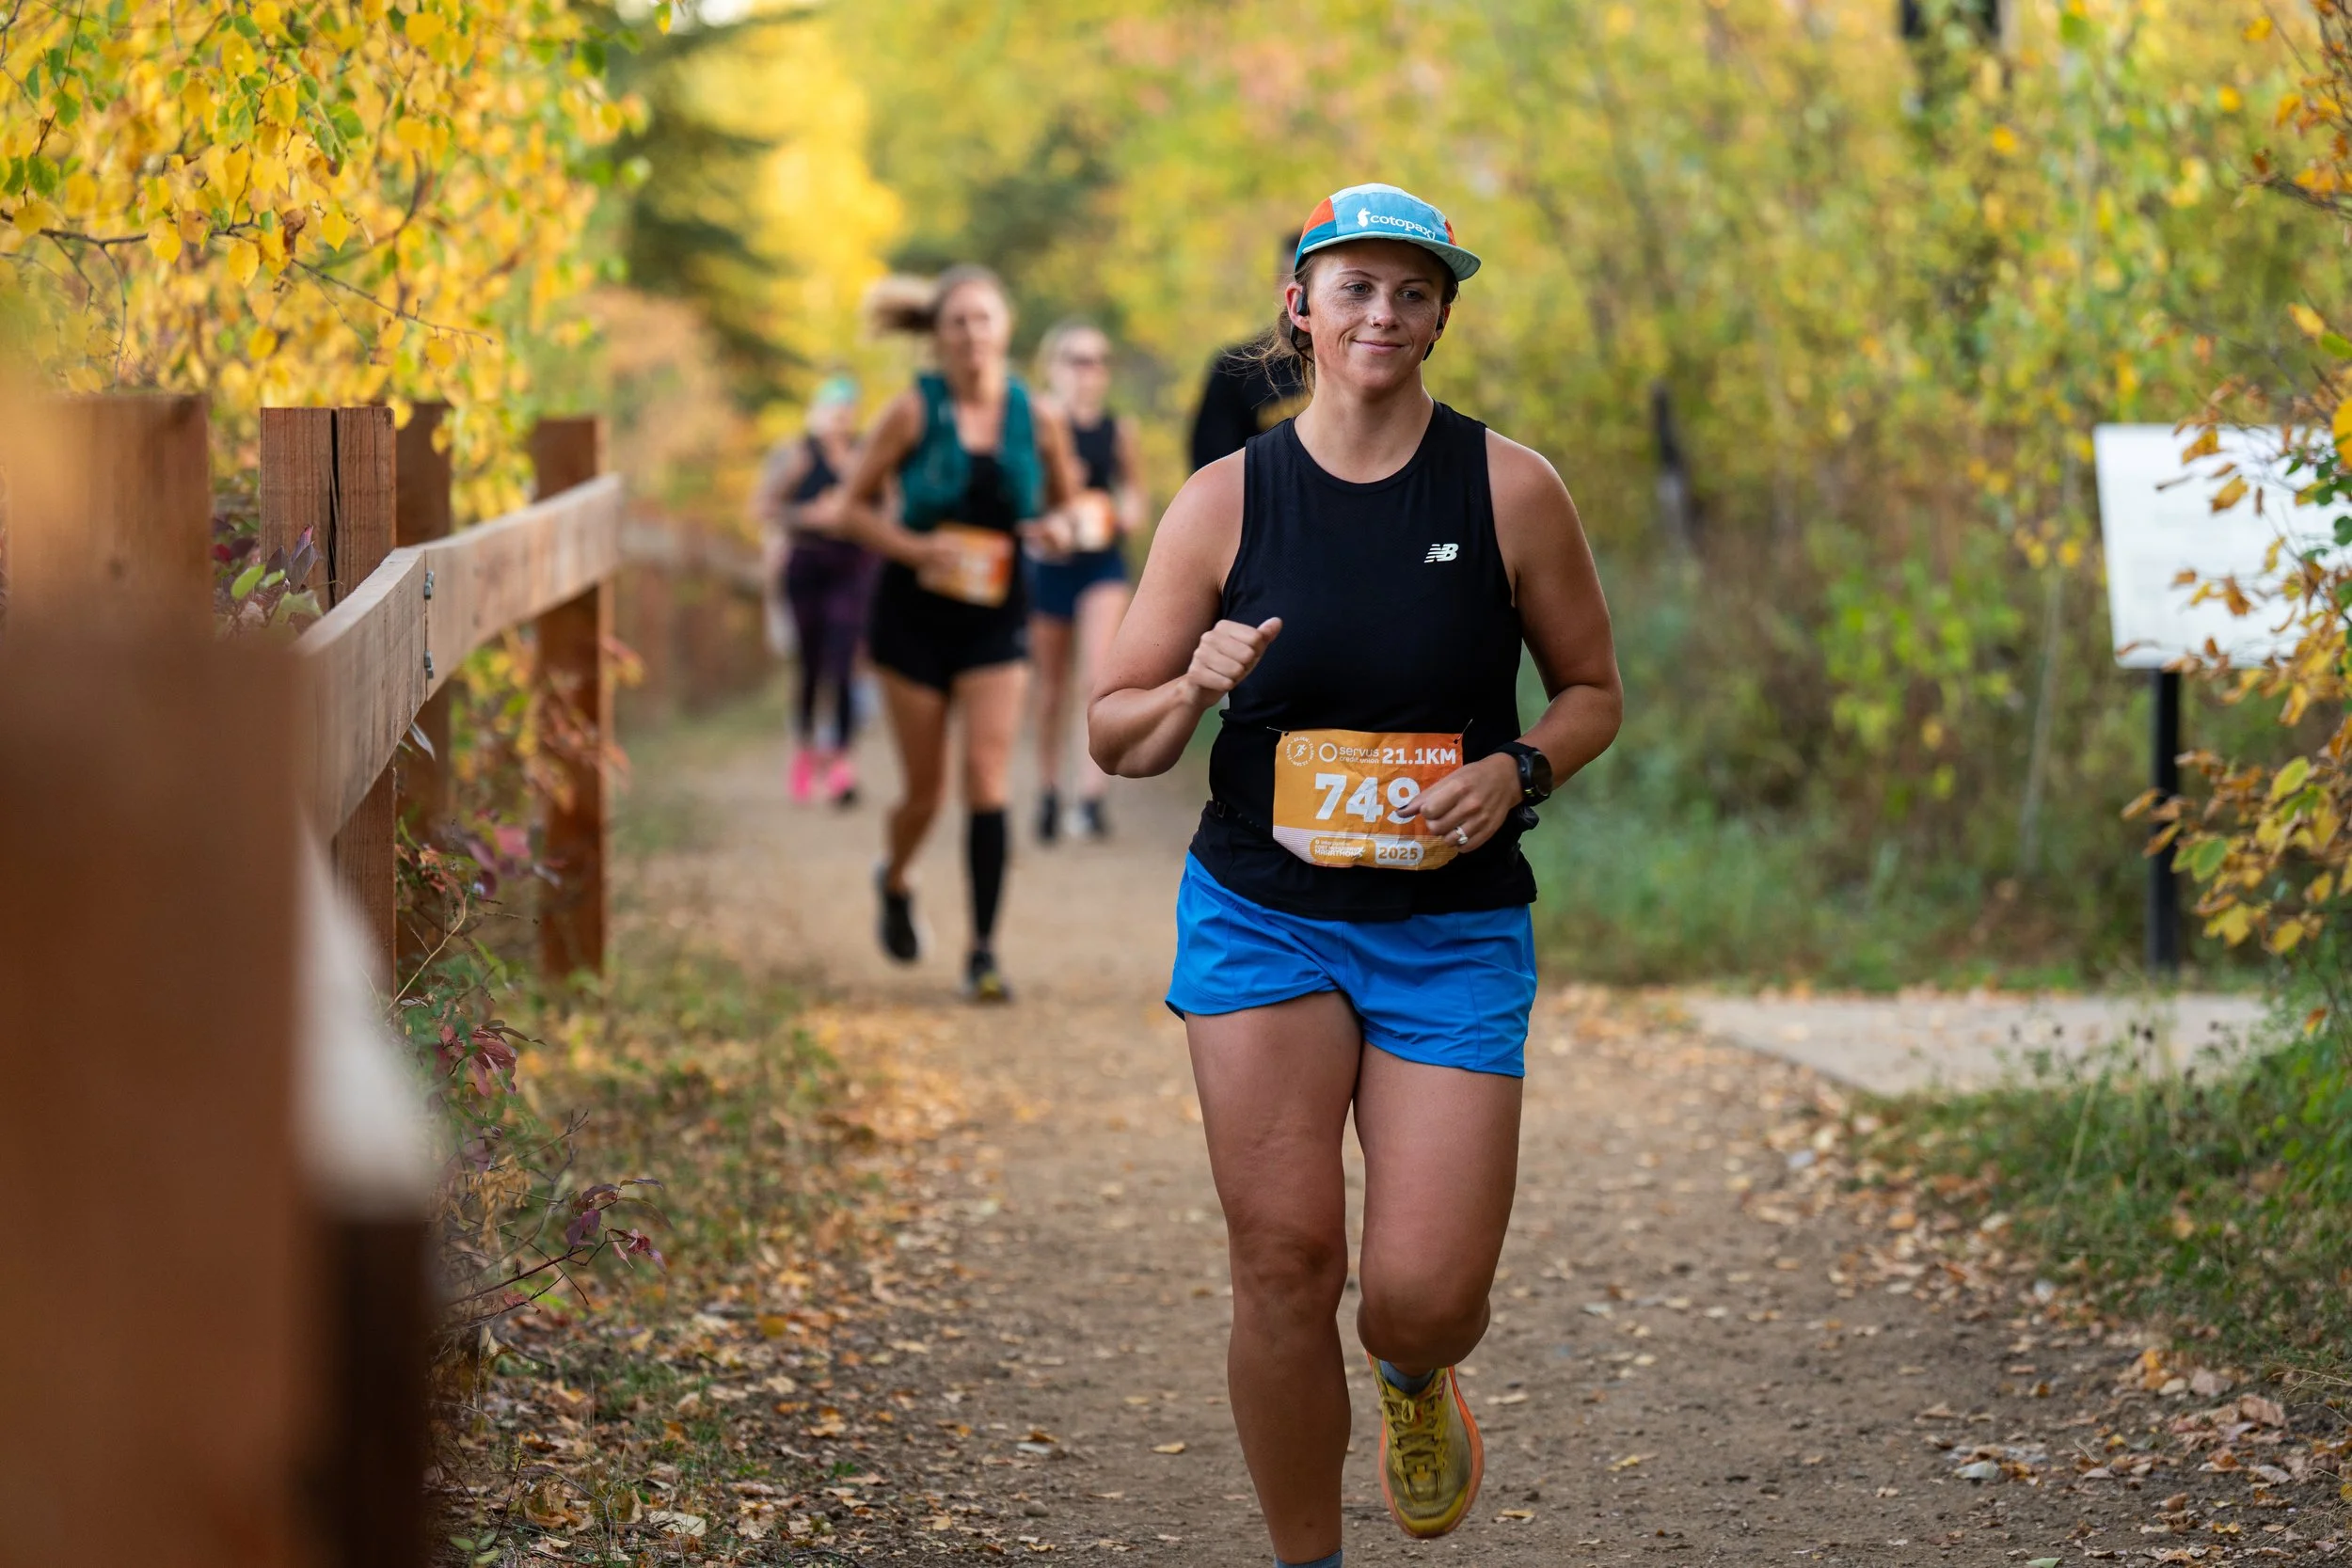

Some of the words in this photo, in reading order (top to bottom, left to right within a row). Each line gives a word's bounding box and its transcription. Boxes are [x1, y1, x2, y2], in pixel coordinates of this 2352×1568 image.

[1339, 746, 1379, 757] servus
[1382, 748, 1456, 765] 21.1KM
[1315, 772, 1421, 825] 749
[1378, 847, 1418, 860] 2025
